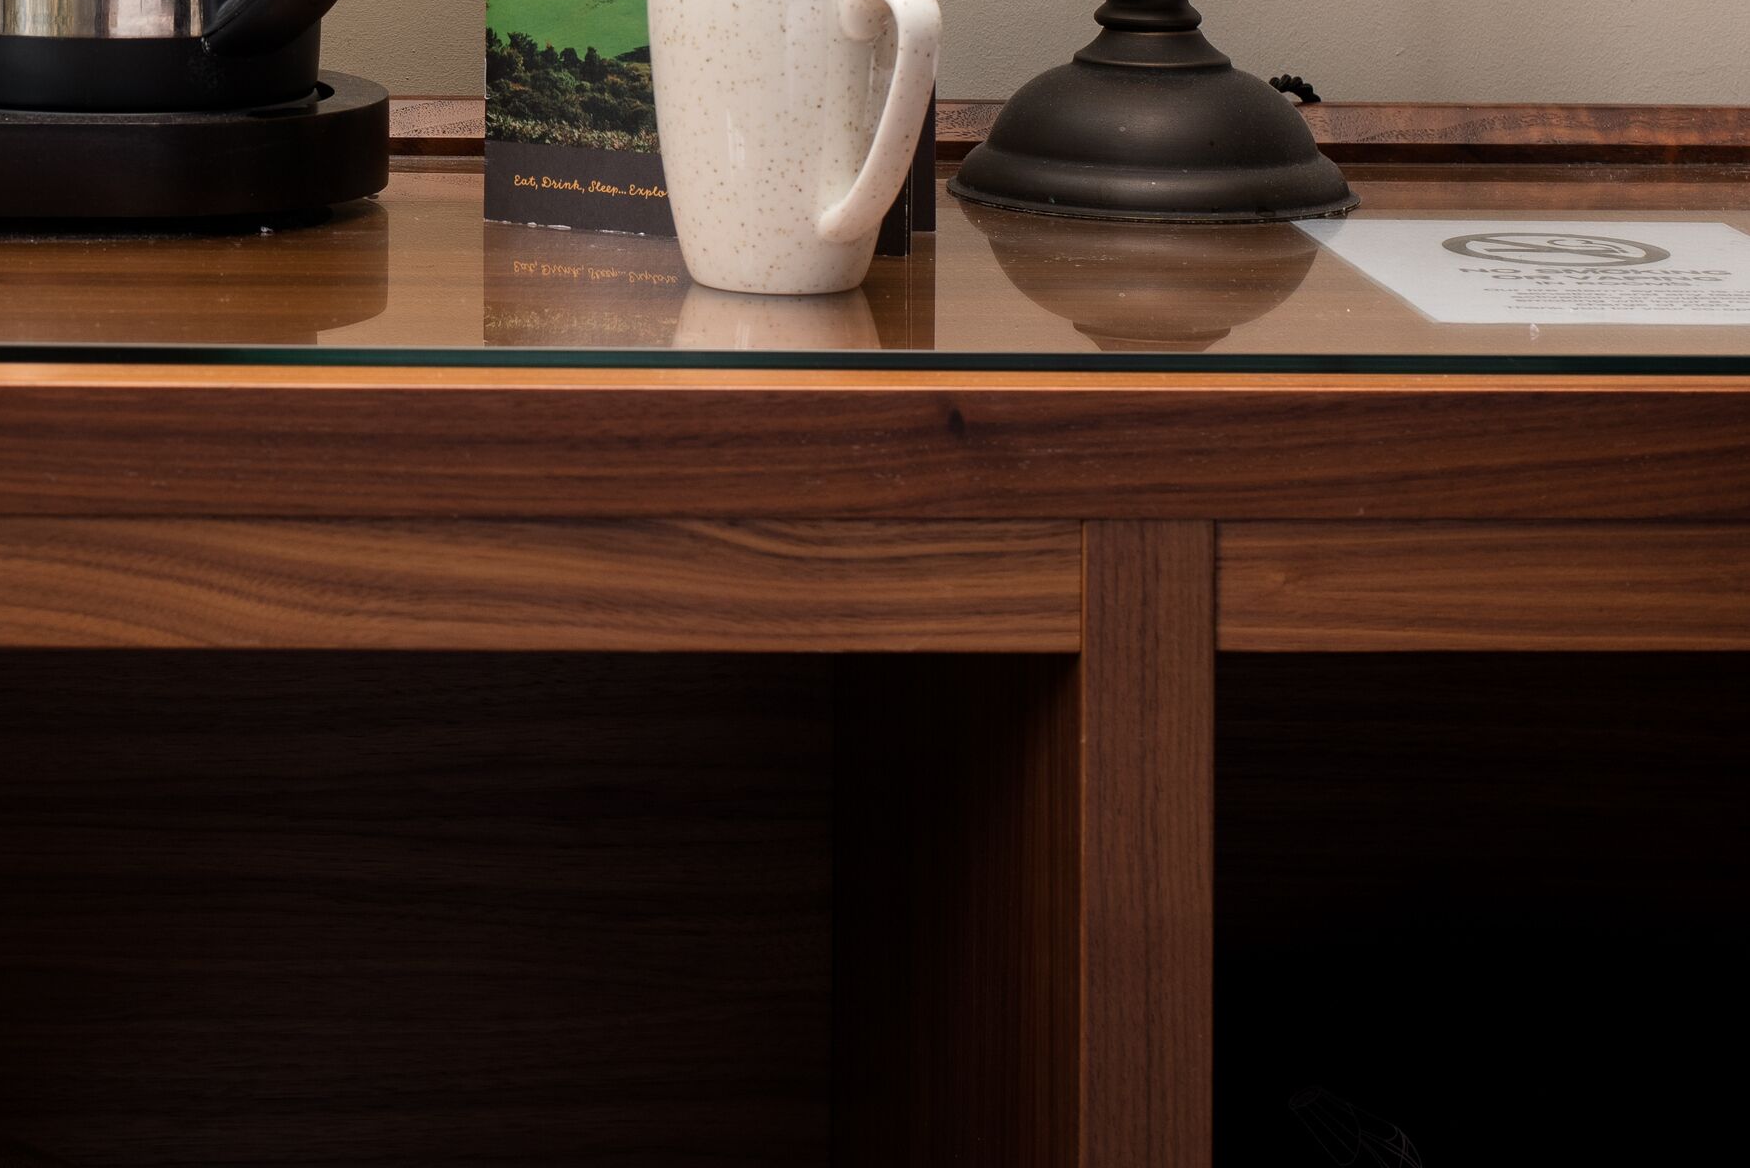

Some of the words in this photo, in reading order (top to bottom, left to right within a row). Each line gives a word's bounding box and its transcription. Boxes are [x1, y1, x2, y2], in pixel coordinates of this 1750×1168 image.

[513, 174, 539, 190] Eat,
[541, 176, 585, 194] Drink,
[587, 180, 627, 197] Sleep...
[628, 184, 670, 199] Explo
